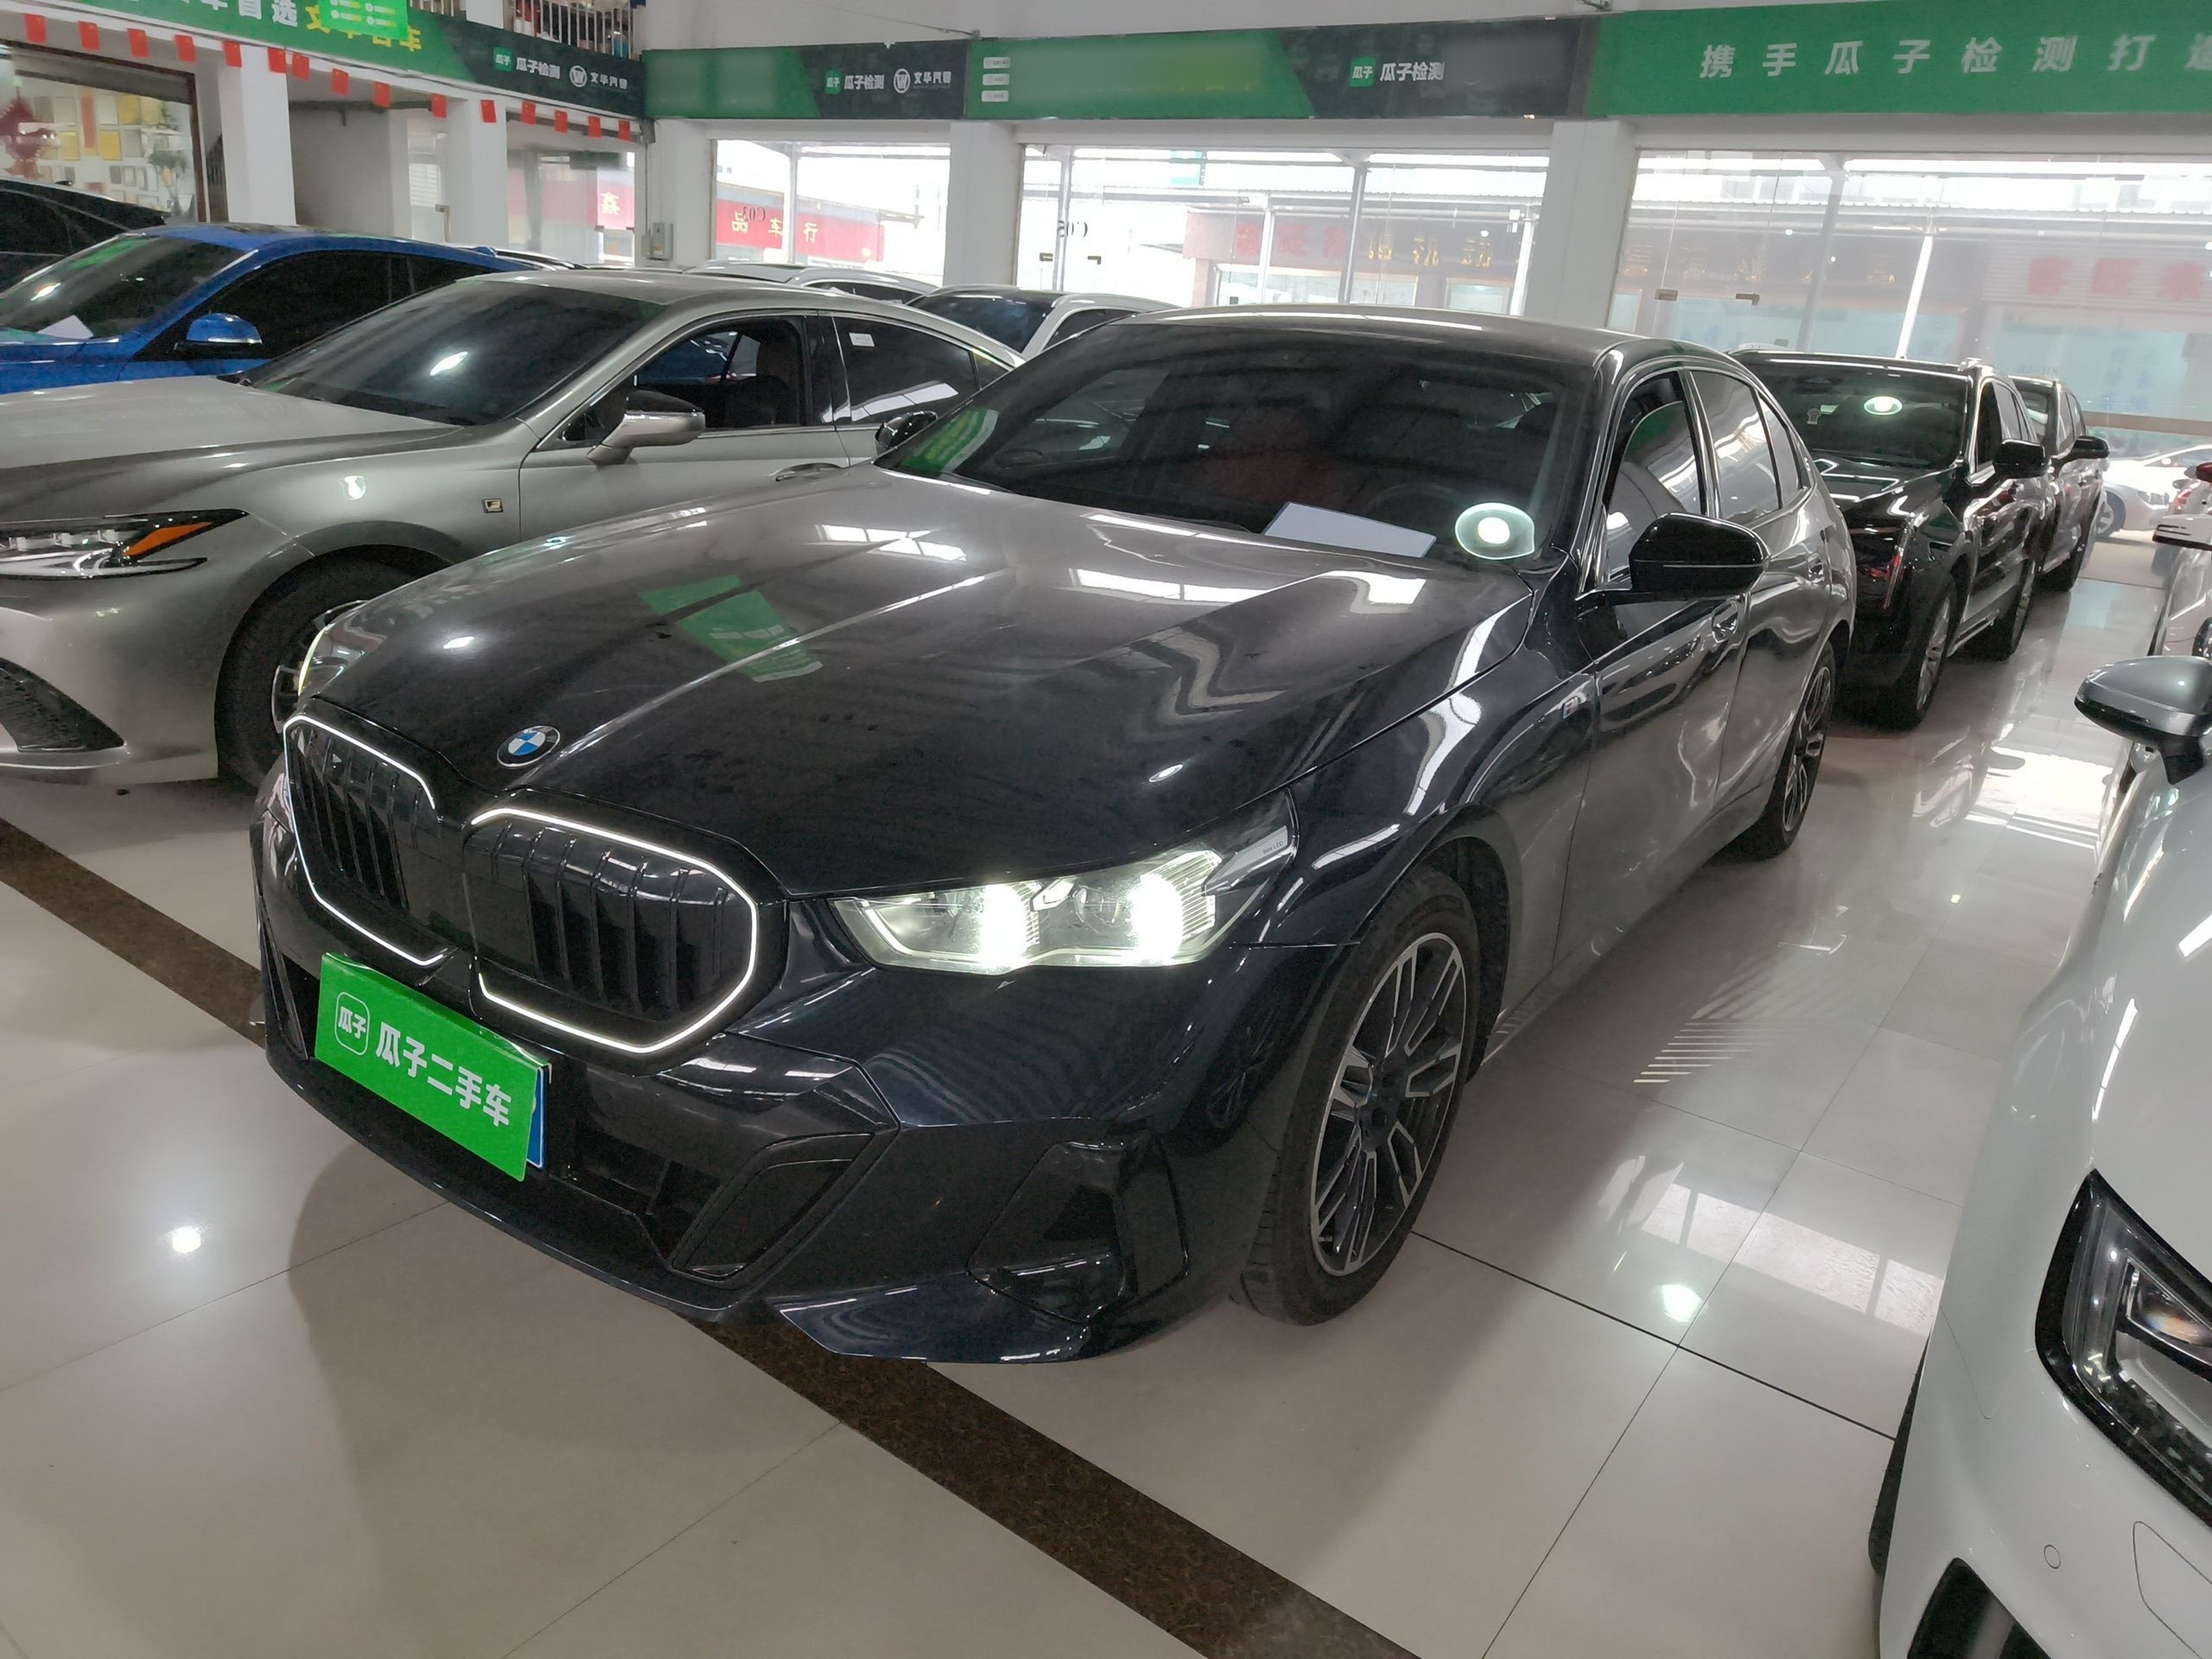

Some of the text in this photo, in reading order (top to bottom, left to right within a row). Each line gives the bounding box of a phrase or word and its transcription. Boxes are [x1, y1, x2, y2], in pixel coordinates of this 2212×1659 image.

[1352, 66, 1373, 79] 瓜子
[1380, 62, 1445, 81] 瓜子检测
[338, 1006, 366, 1039] 瓜子
[375, 1021, 512, 1127] 瓜子二手车
